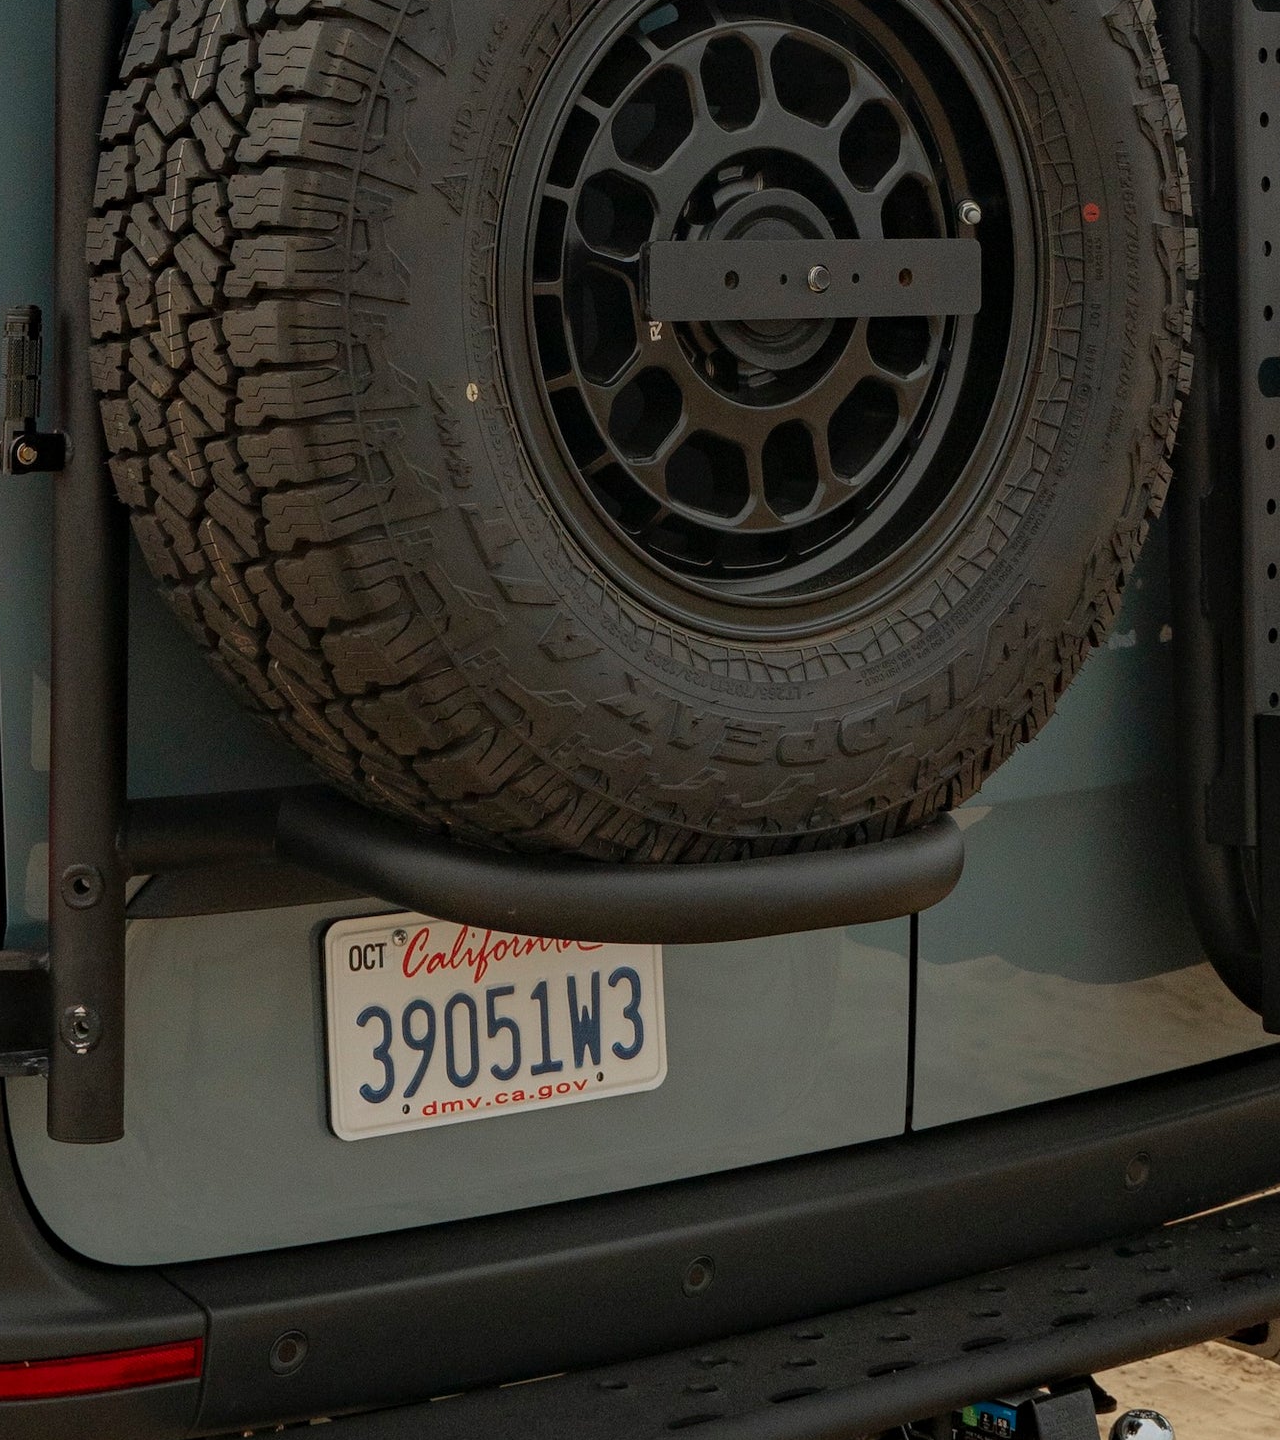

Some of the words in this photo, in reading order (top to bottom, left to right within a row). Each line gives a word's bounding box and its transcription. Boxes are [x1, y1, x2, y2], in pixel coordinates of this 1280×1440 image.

[349, 942, 387, 972] OCT
[356, 966, 645, 1104] 39051W3
[421, 1077, 588, 1118] dmv.ca.gov
